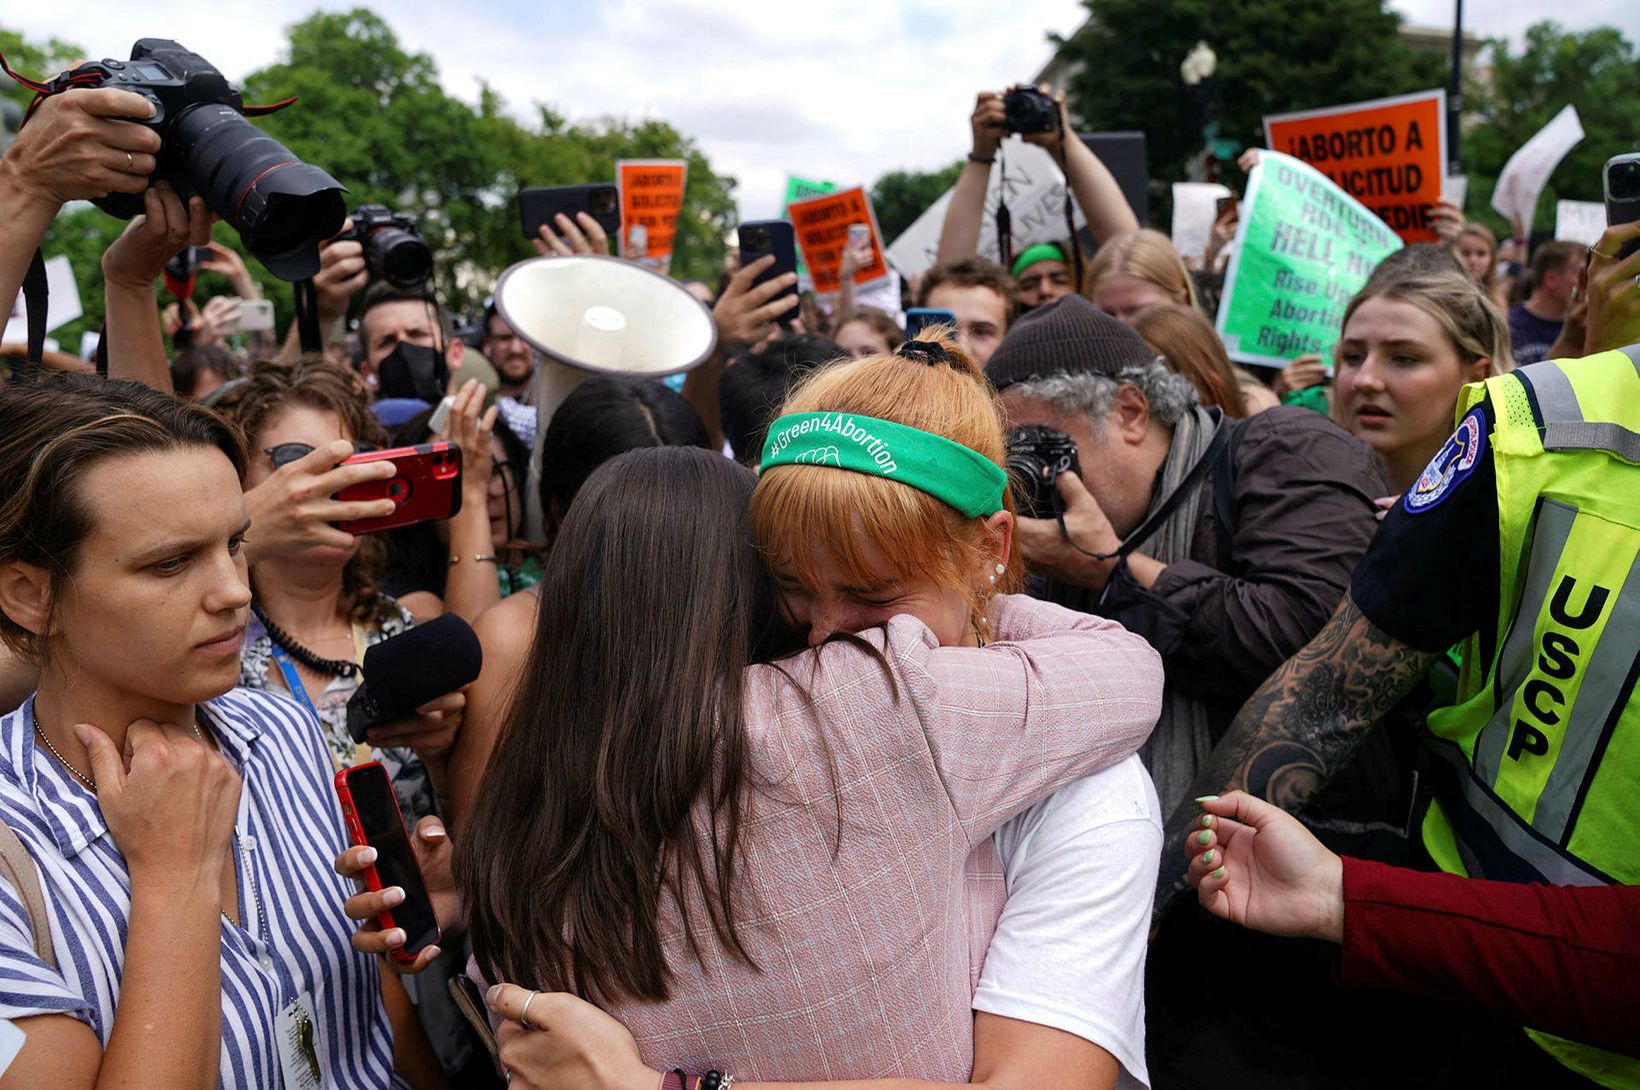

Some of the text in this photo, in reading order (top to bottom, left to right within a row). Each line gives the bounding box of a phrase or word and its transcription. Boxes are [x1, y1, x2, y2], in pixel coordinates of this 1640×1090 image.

[1406, 120, 1424, 151] A
[1277, 166, 1389, 251] OVERTURN
[1371, 203, 1434, 232] EDI
[1271, 221, 1336, 267] HELL
[1273, 267, 1320, 297] Rise
[1257, 325, 1322, 355] Rights
[770, 413, 897, 475] #Green4Abortion
[1506, 574, 1611, 763] USCP
